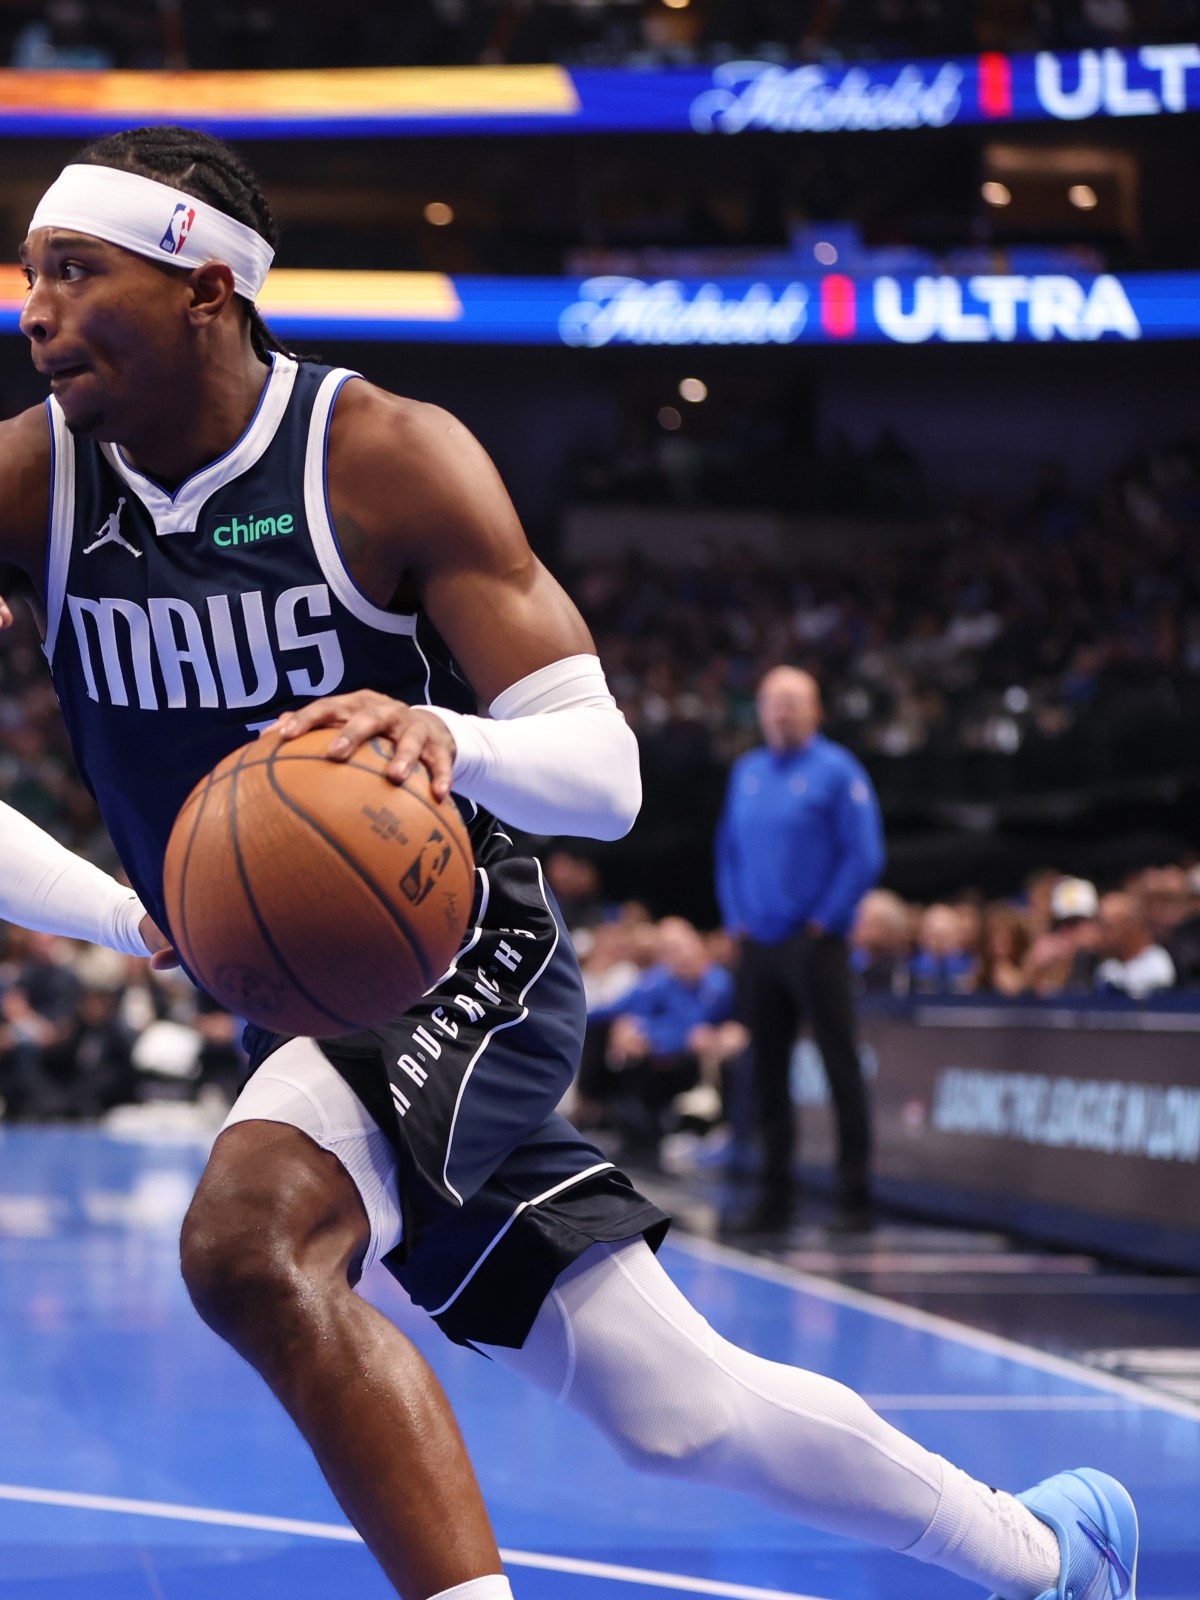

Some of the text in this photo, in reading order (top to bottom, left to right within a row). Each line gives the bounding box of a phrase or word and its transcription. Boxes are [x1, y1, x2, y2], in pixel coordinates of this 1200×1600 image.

[1035, 43, 1200, 120] ULT
[873, 274, 1141, 342] ULTRA
[213, 513, 294, 547] chime
[67, 583, 345, 711] MAVS
